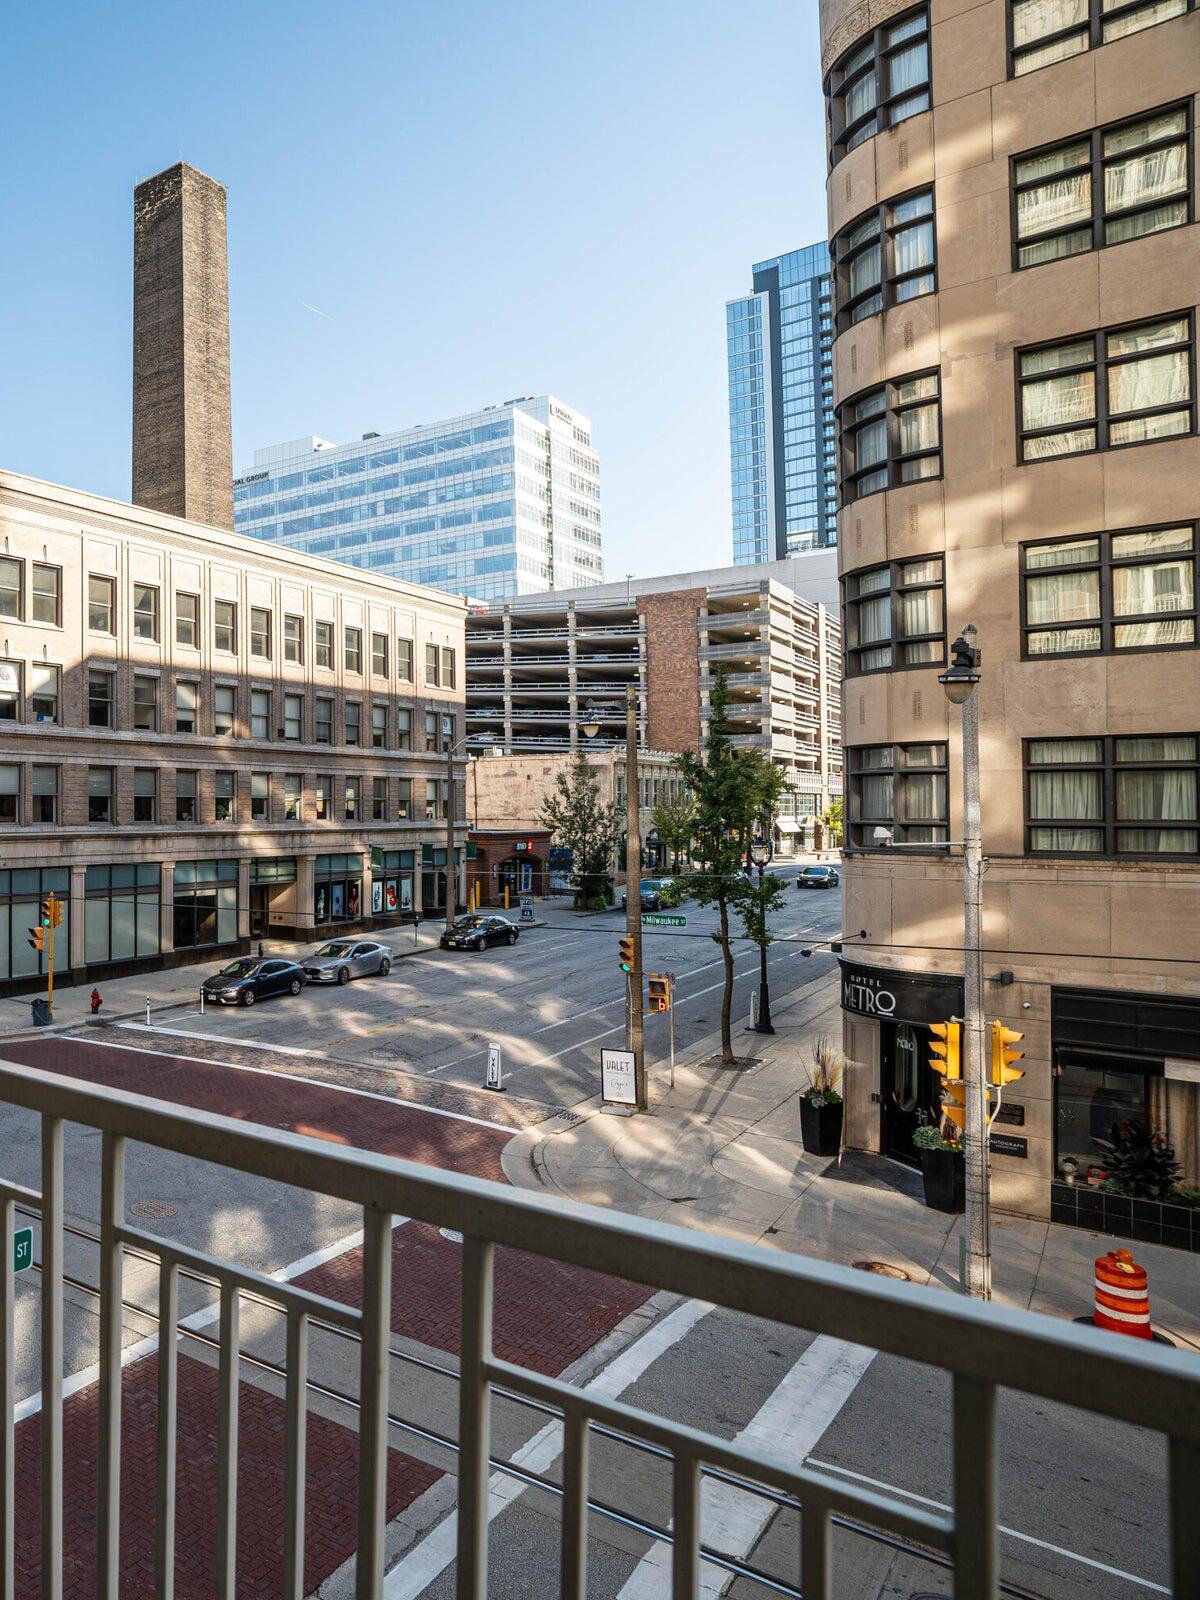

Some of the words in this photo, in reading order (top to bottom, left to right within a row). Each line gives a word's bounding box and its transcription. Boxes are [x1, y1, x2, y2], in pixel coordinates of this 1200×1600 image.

[246, 471, 269, 482] GROUP
[646, 916, 680, 926] Milwaukee
[850, 975, 882, 987] HOTEL
[844, 981, 896, 1016] METRO
[606, 1060, 630, 1072] VALET
[17, 1241, 29, 1258] ST
